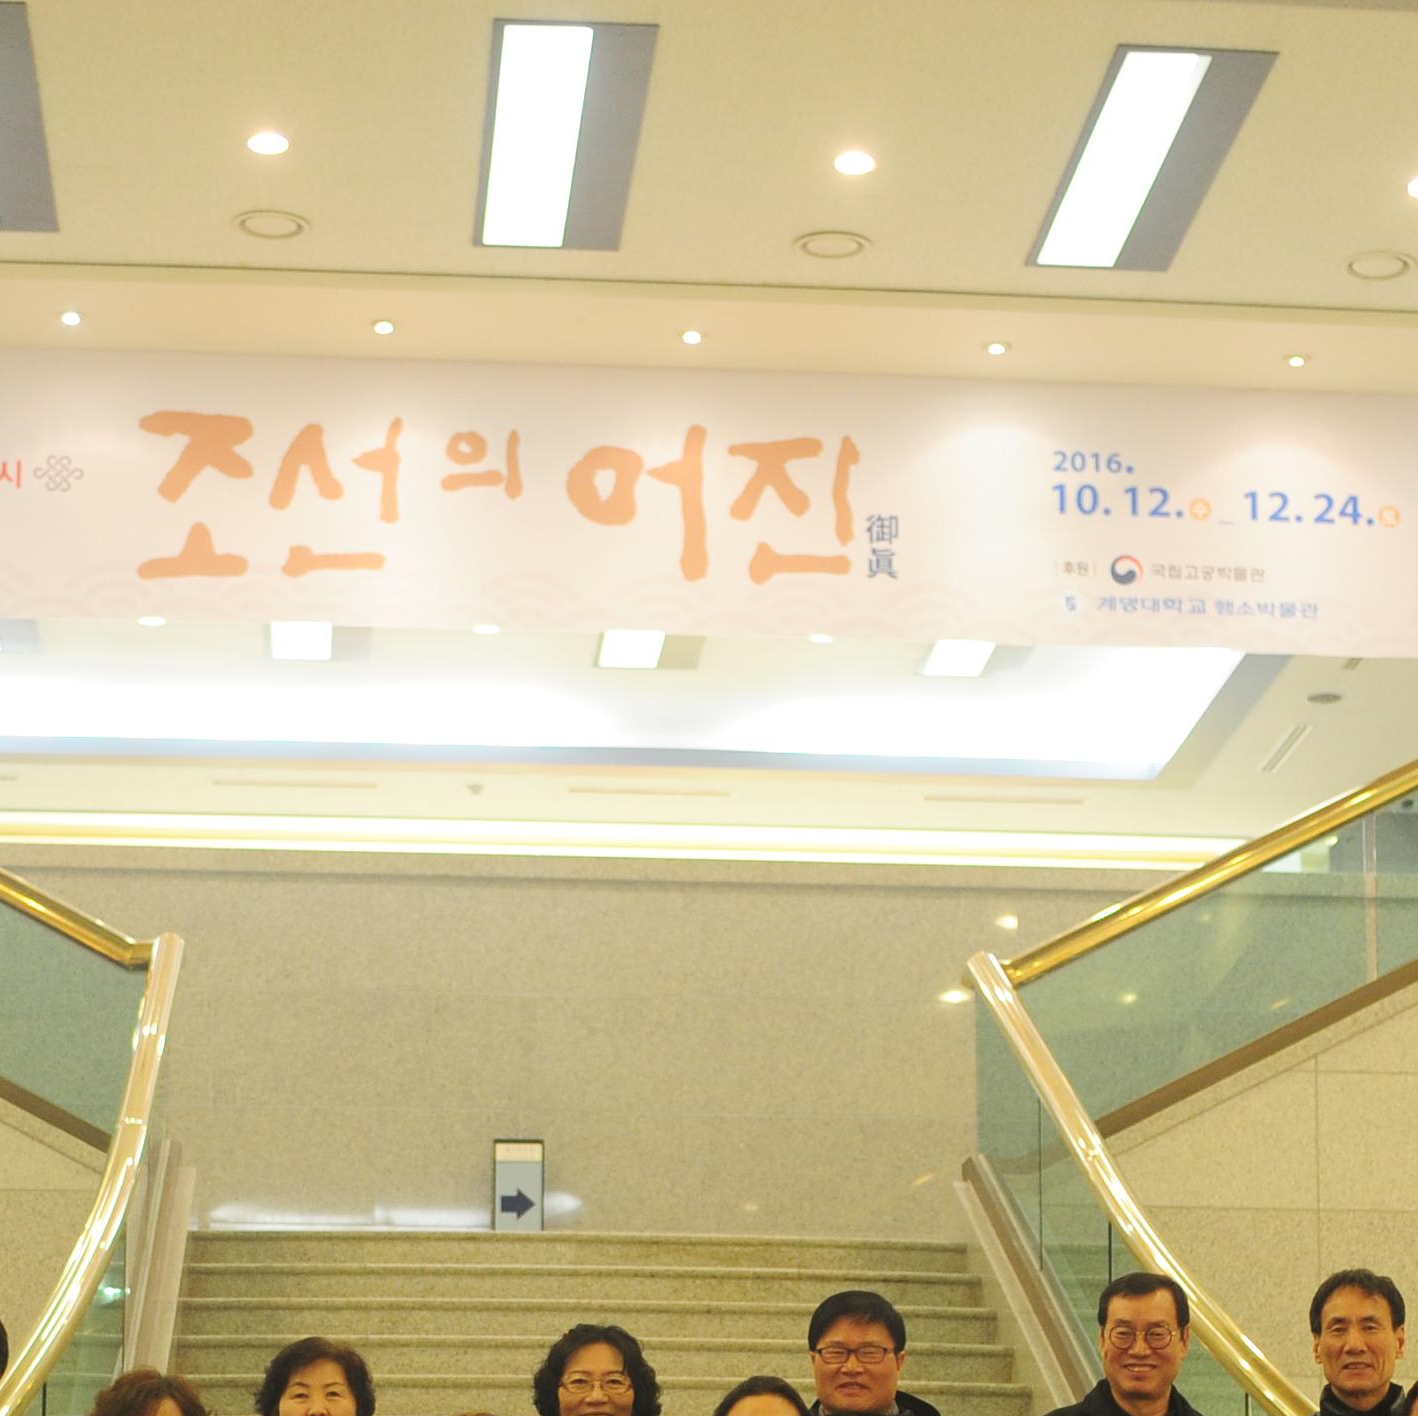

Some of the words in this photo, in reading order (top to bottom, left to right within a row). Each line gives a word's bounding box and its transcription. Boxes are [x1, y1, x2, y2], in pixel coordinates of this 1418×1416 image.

[137, 411, 522, 579] 조선의
[566, 424, 861, 583] 어진
[1052, 451, 1134, 474] 2016.
